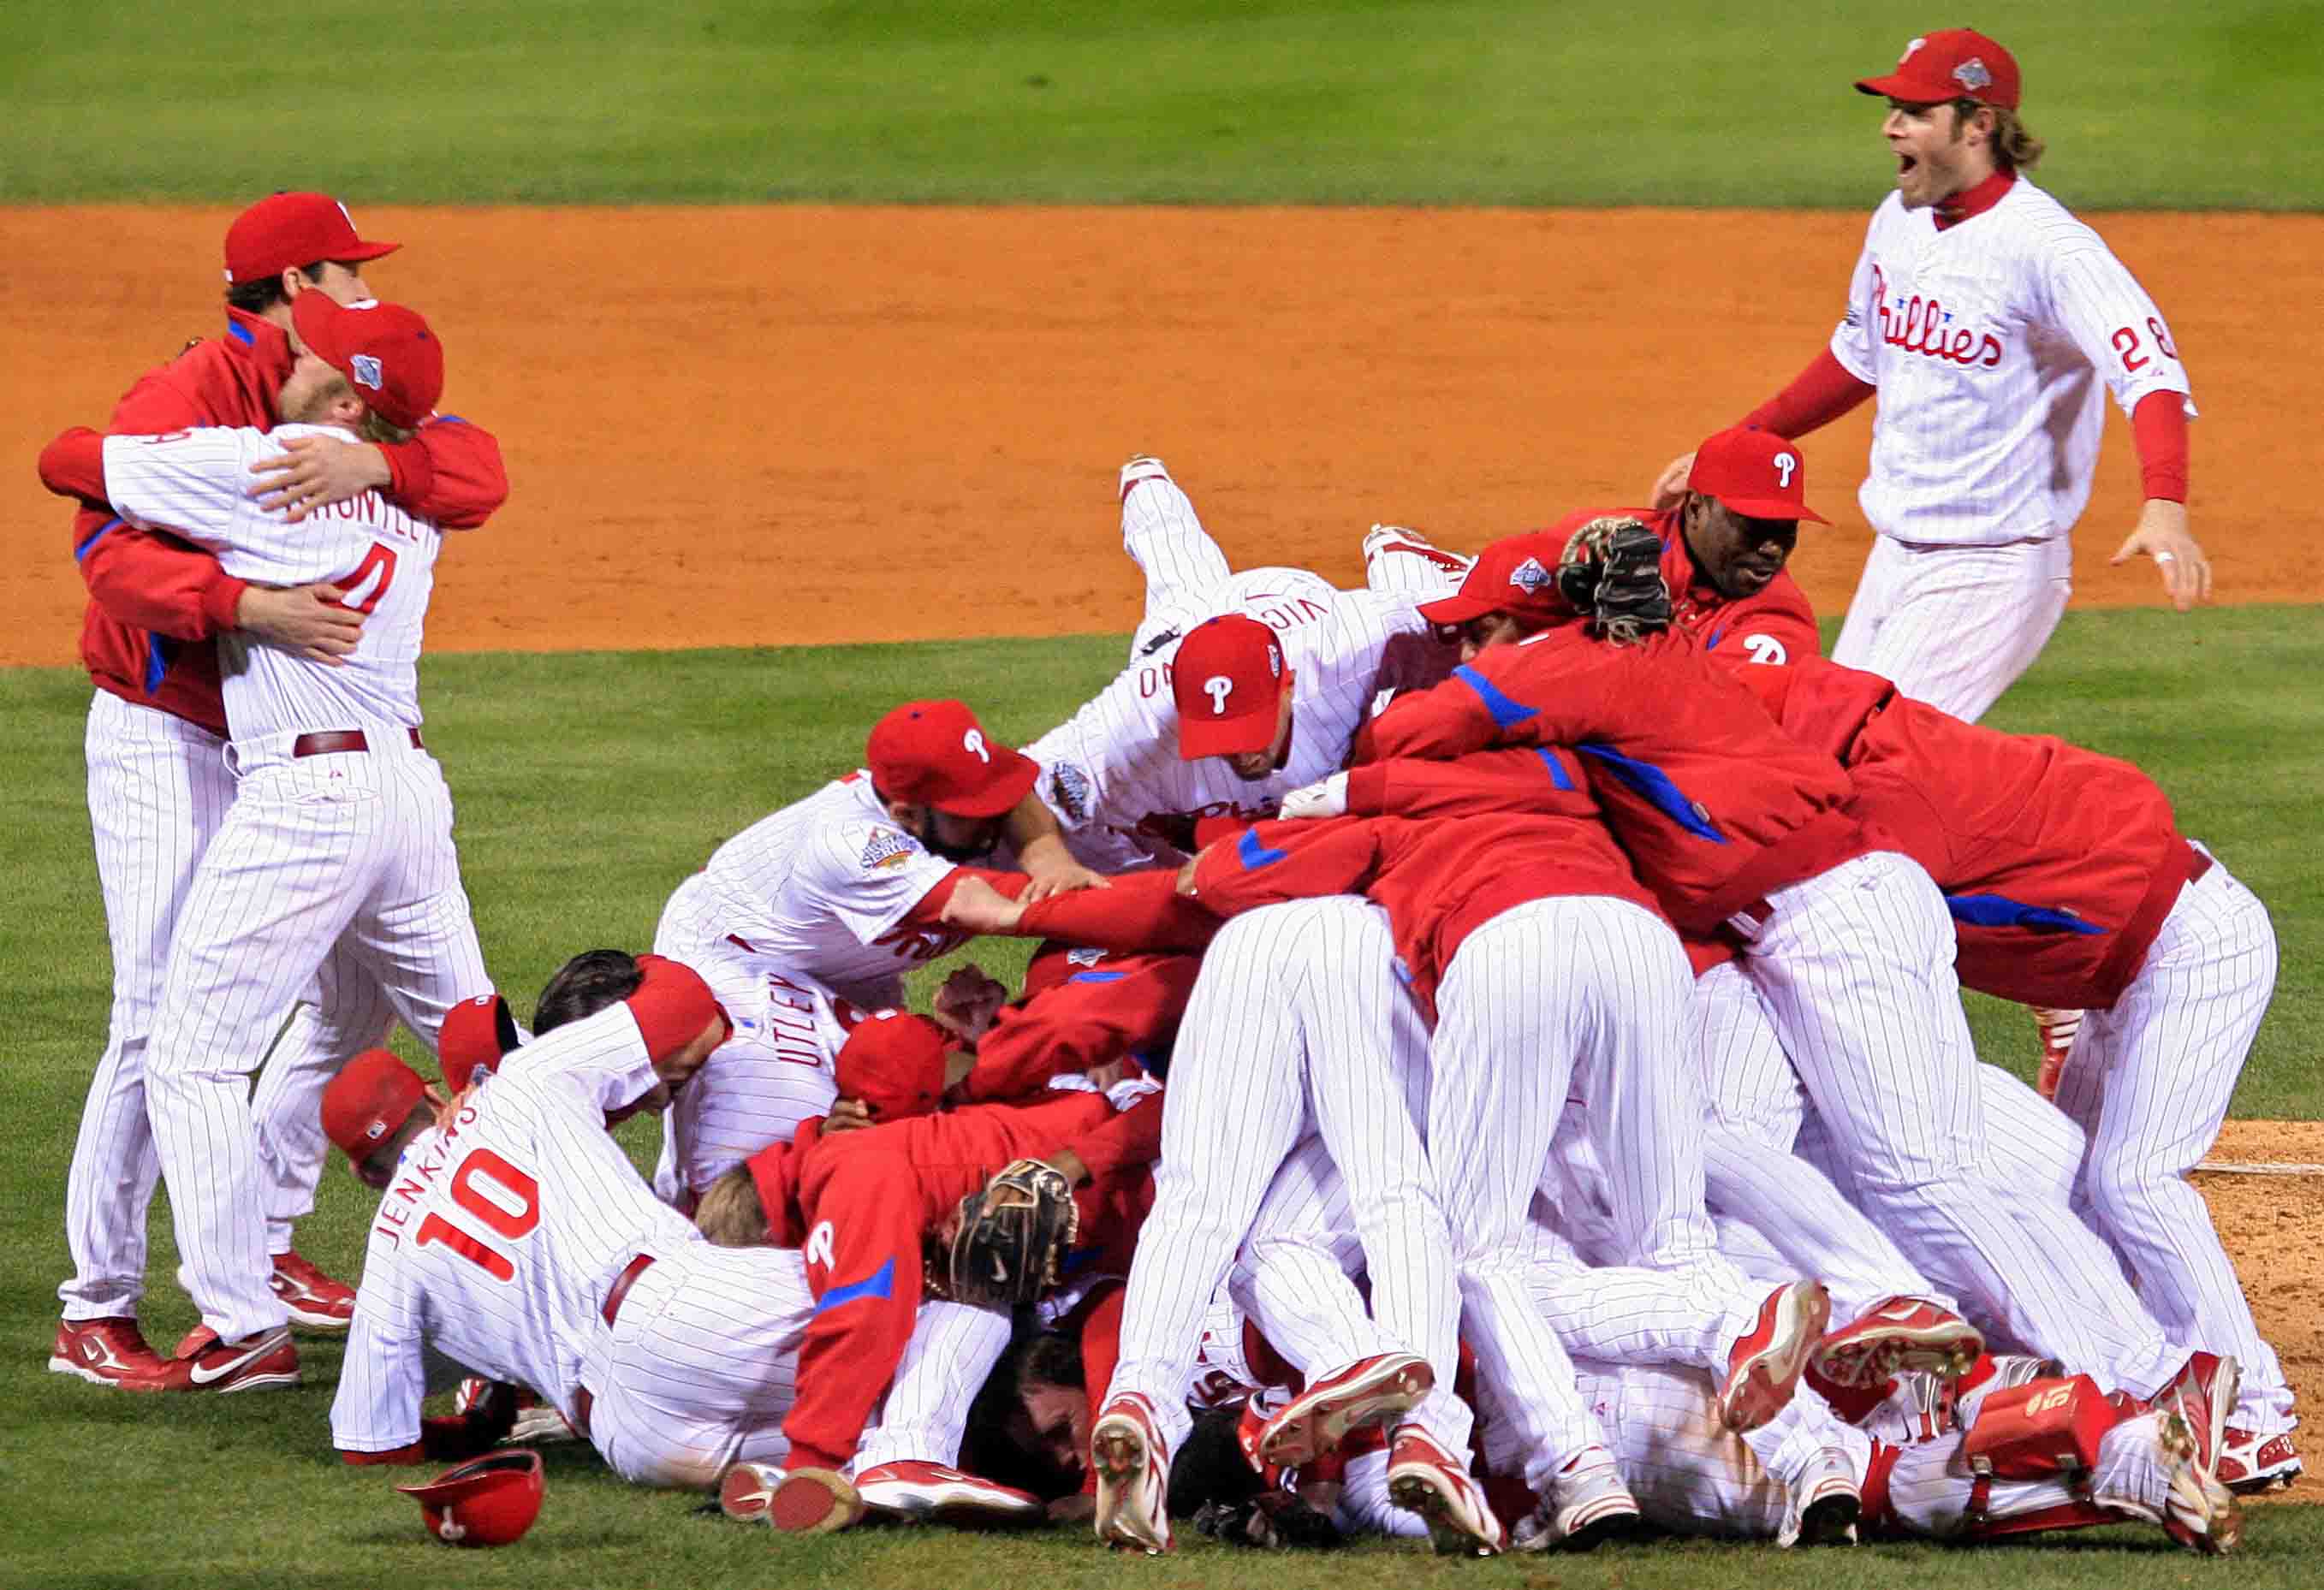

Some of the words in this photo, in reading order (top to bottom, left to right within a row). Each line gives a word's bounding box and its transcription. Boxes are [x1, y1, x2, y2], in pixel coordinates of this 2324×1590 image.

[2112, 317, 2178, 371] 28
[1774, 453, 1795, 488] P
[1204, 675, 1233, 715] P
[964, 728, 990, 762] P
[768, 972, 822, 1067] UTLEY
[416, 1148, 541, 1282] 10
[807, 1221, 835, 1273] P
